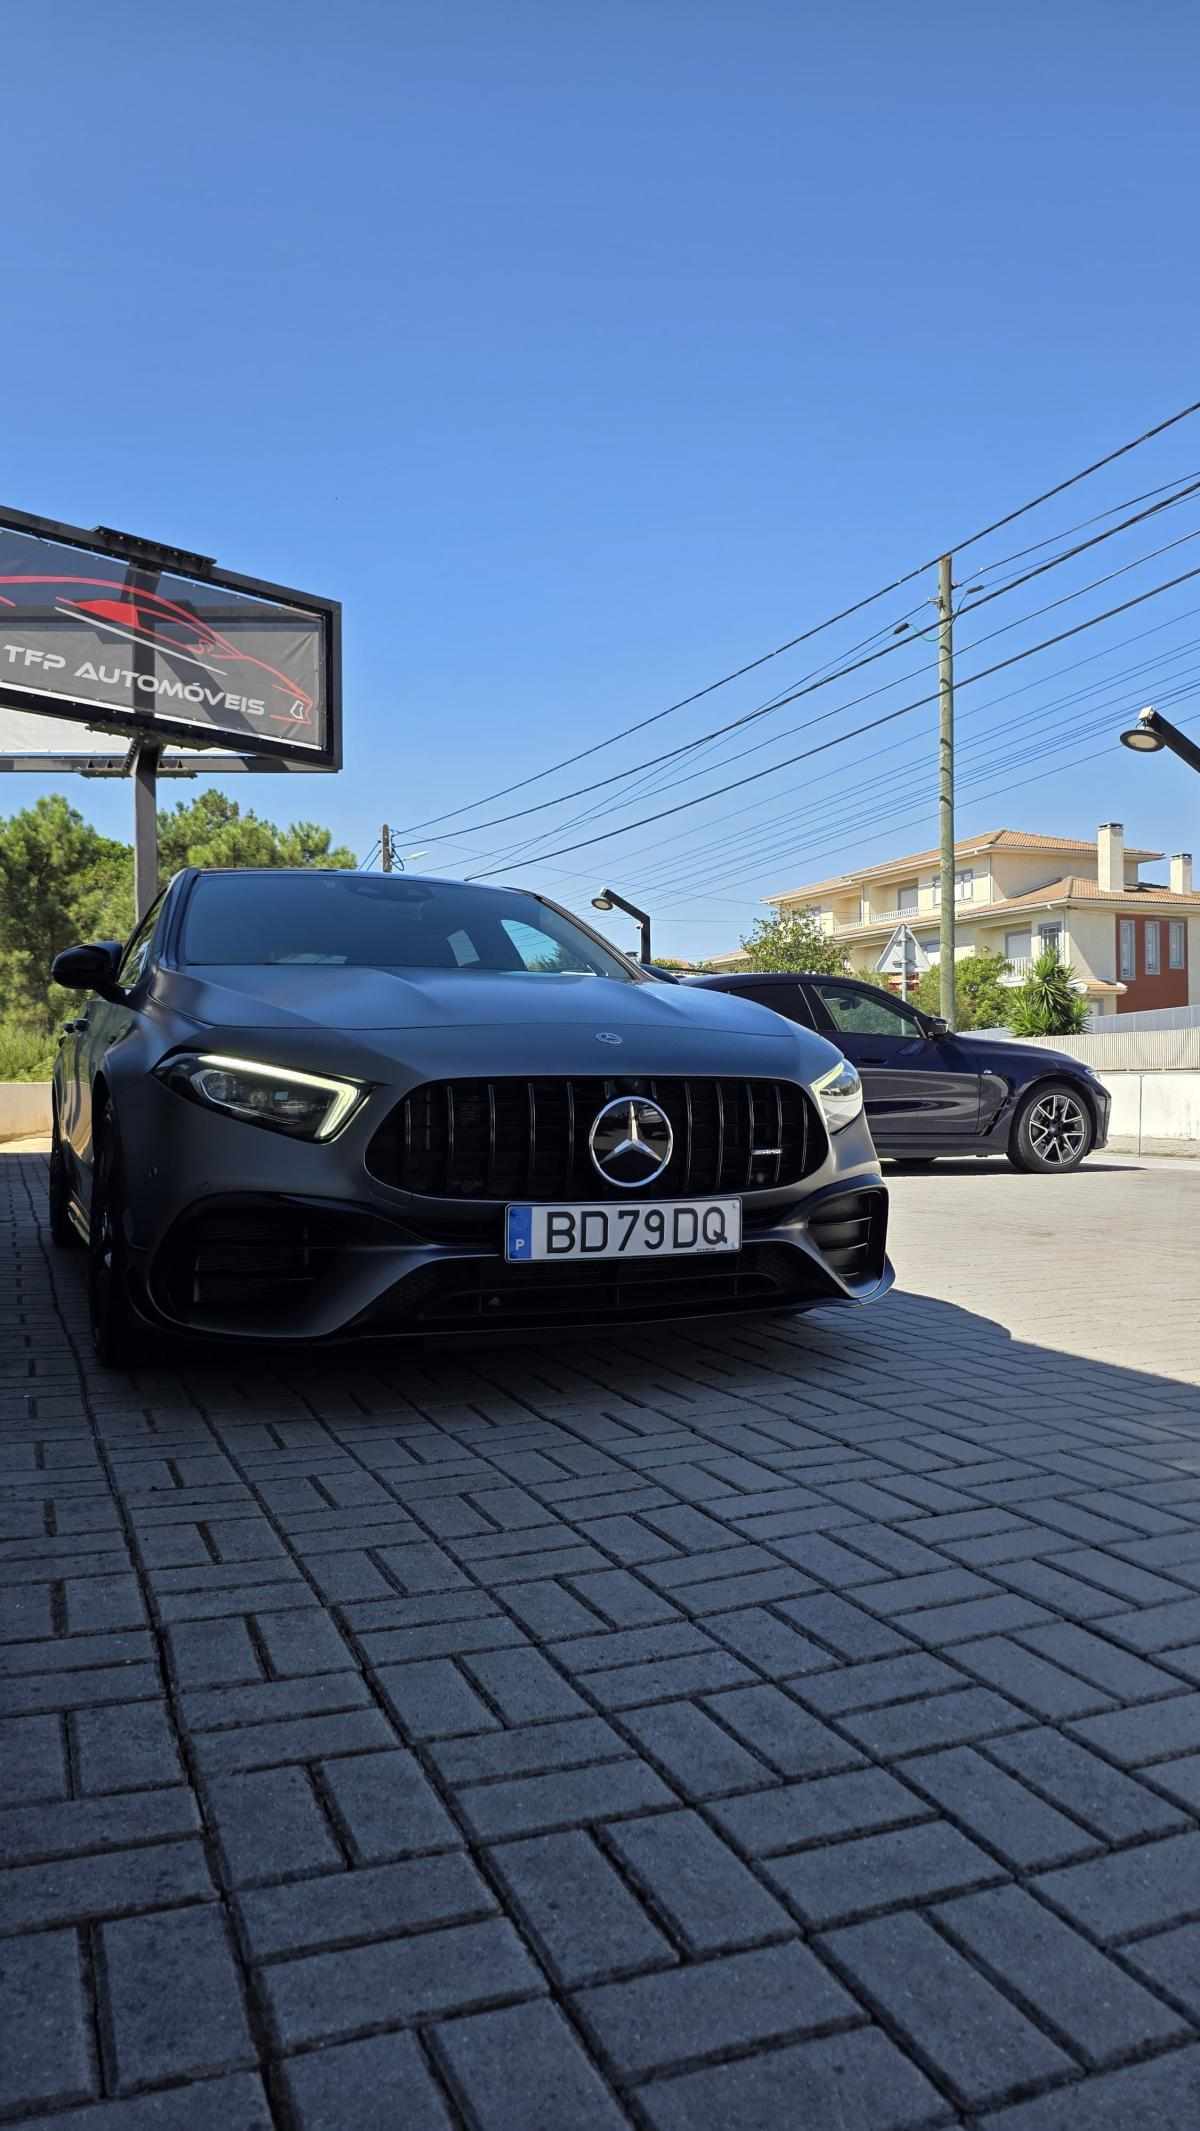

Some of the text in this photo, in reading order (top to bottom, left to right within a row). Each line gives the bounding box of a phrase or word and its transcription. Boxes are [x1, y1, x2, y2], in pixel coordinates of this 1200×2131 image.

[3, 644, 265, 715] TFP AUTOMÓVEIS
[515, 1238, 526, 1251] P
